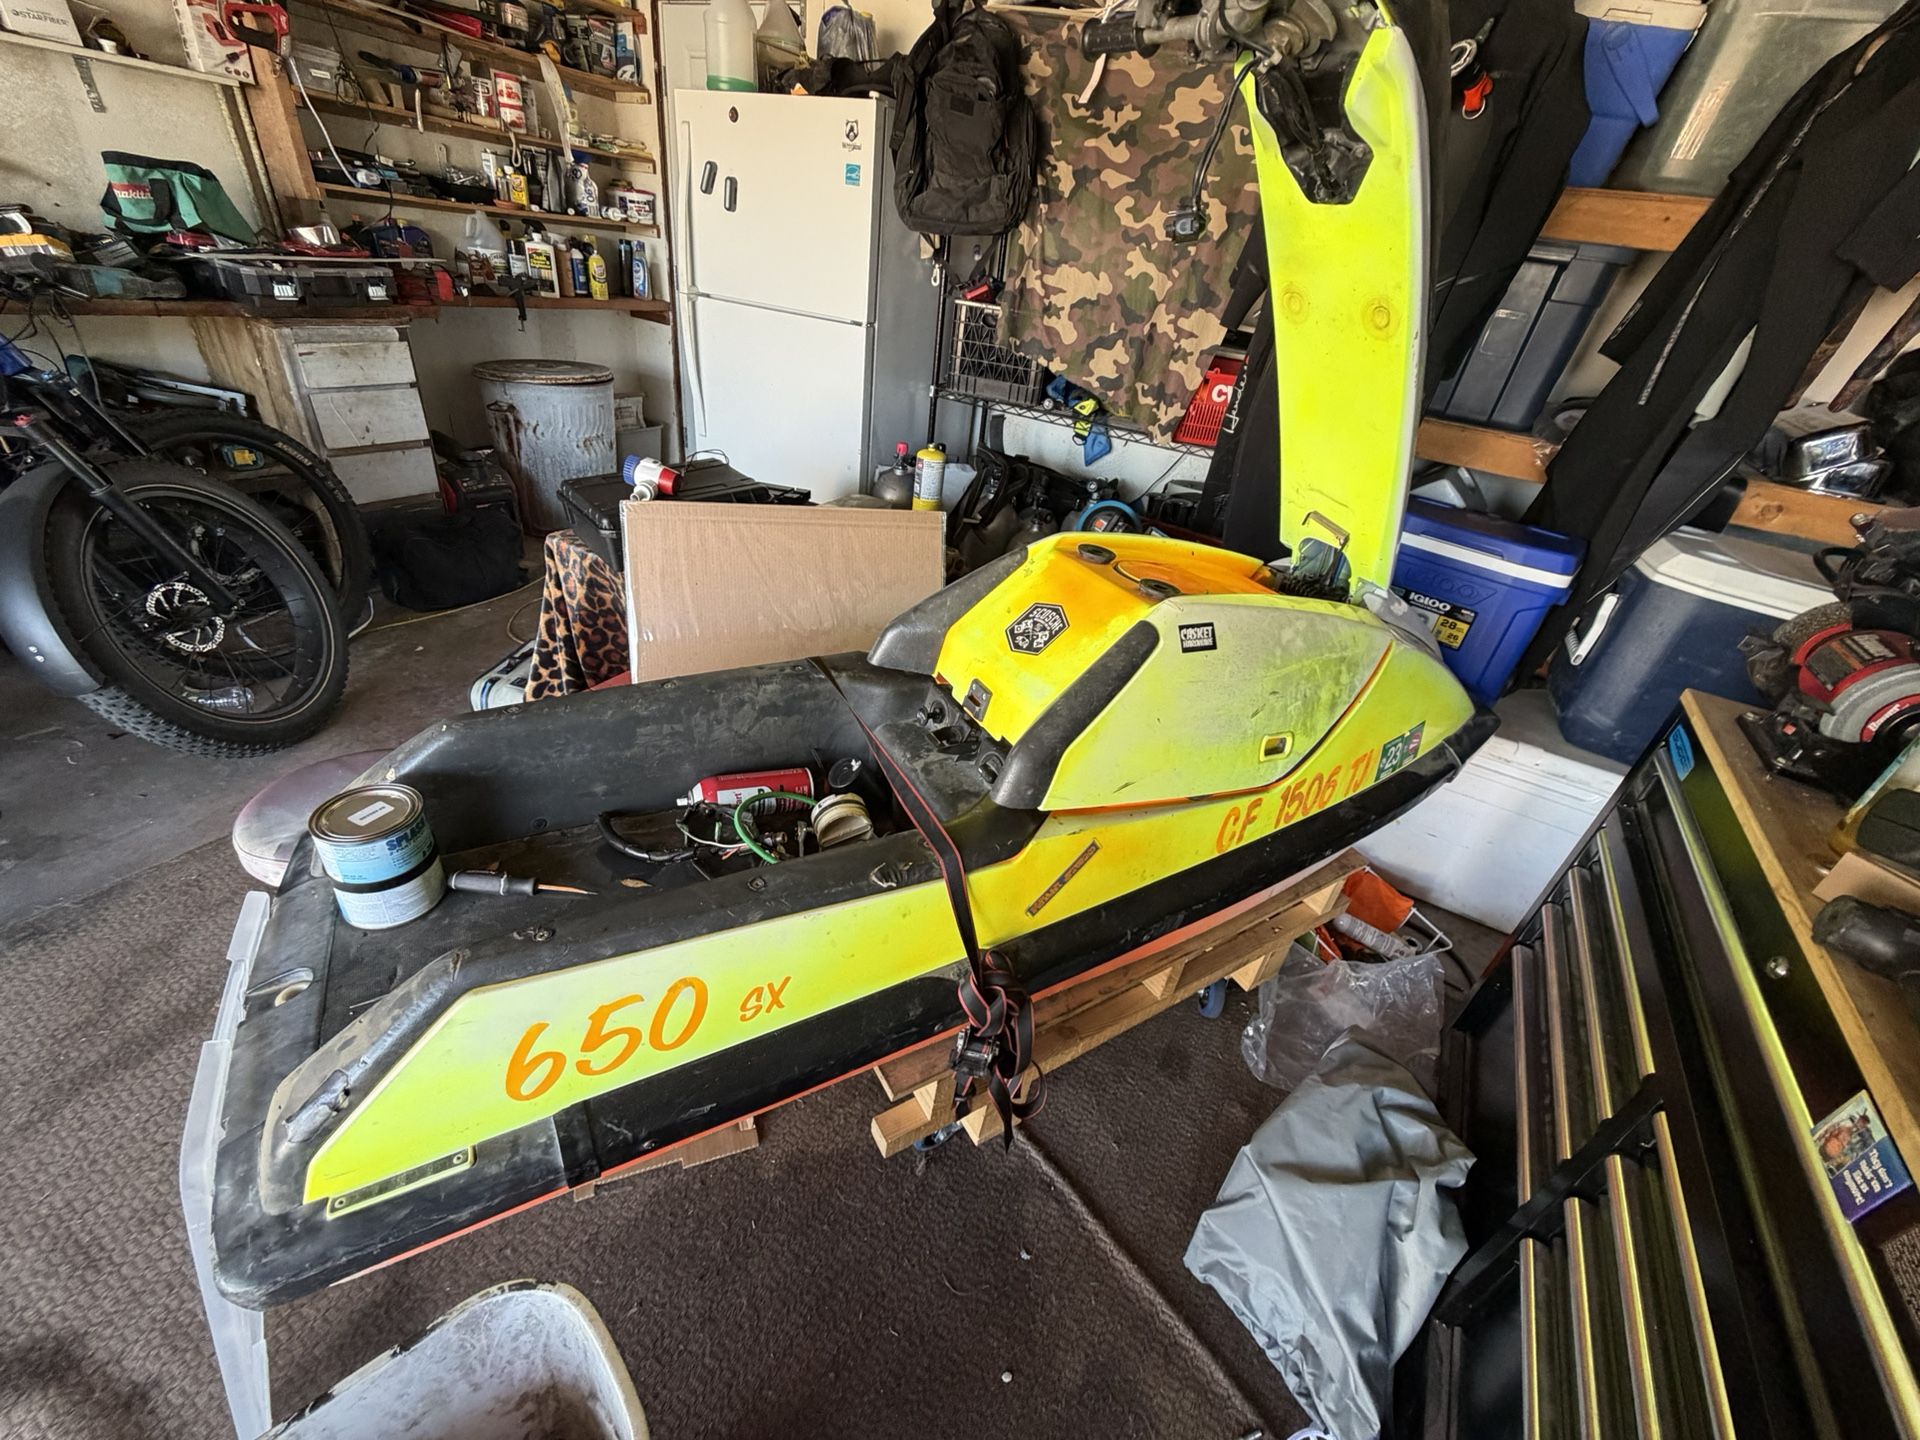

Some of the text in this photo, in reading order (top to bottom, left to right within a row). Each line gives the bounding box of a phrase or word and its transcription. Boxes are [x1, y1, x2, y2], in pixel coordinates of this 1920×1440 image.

[1409, 591, 1451, 612] IGLOO
[1029, 607, 1064, 635] SCOSCHE
[1180, 626, 1213, 641] CASKET
[1440, 618, 1458, 630] 28
[1383, 742, 1403, 770] 23
[1216, 797, 1264, 854] CF
[1274, 764, 1342, 830] 1506
[505, 975, 792, 1101] 650 SX
